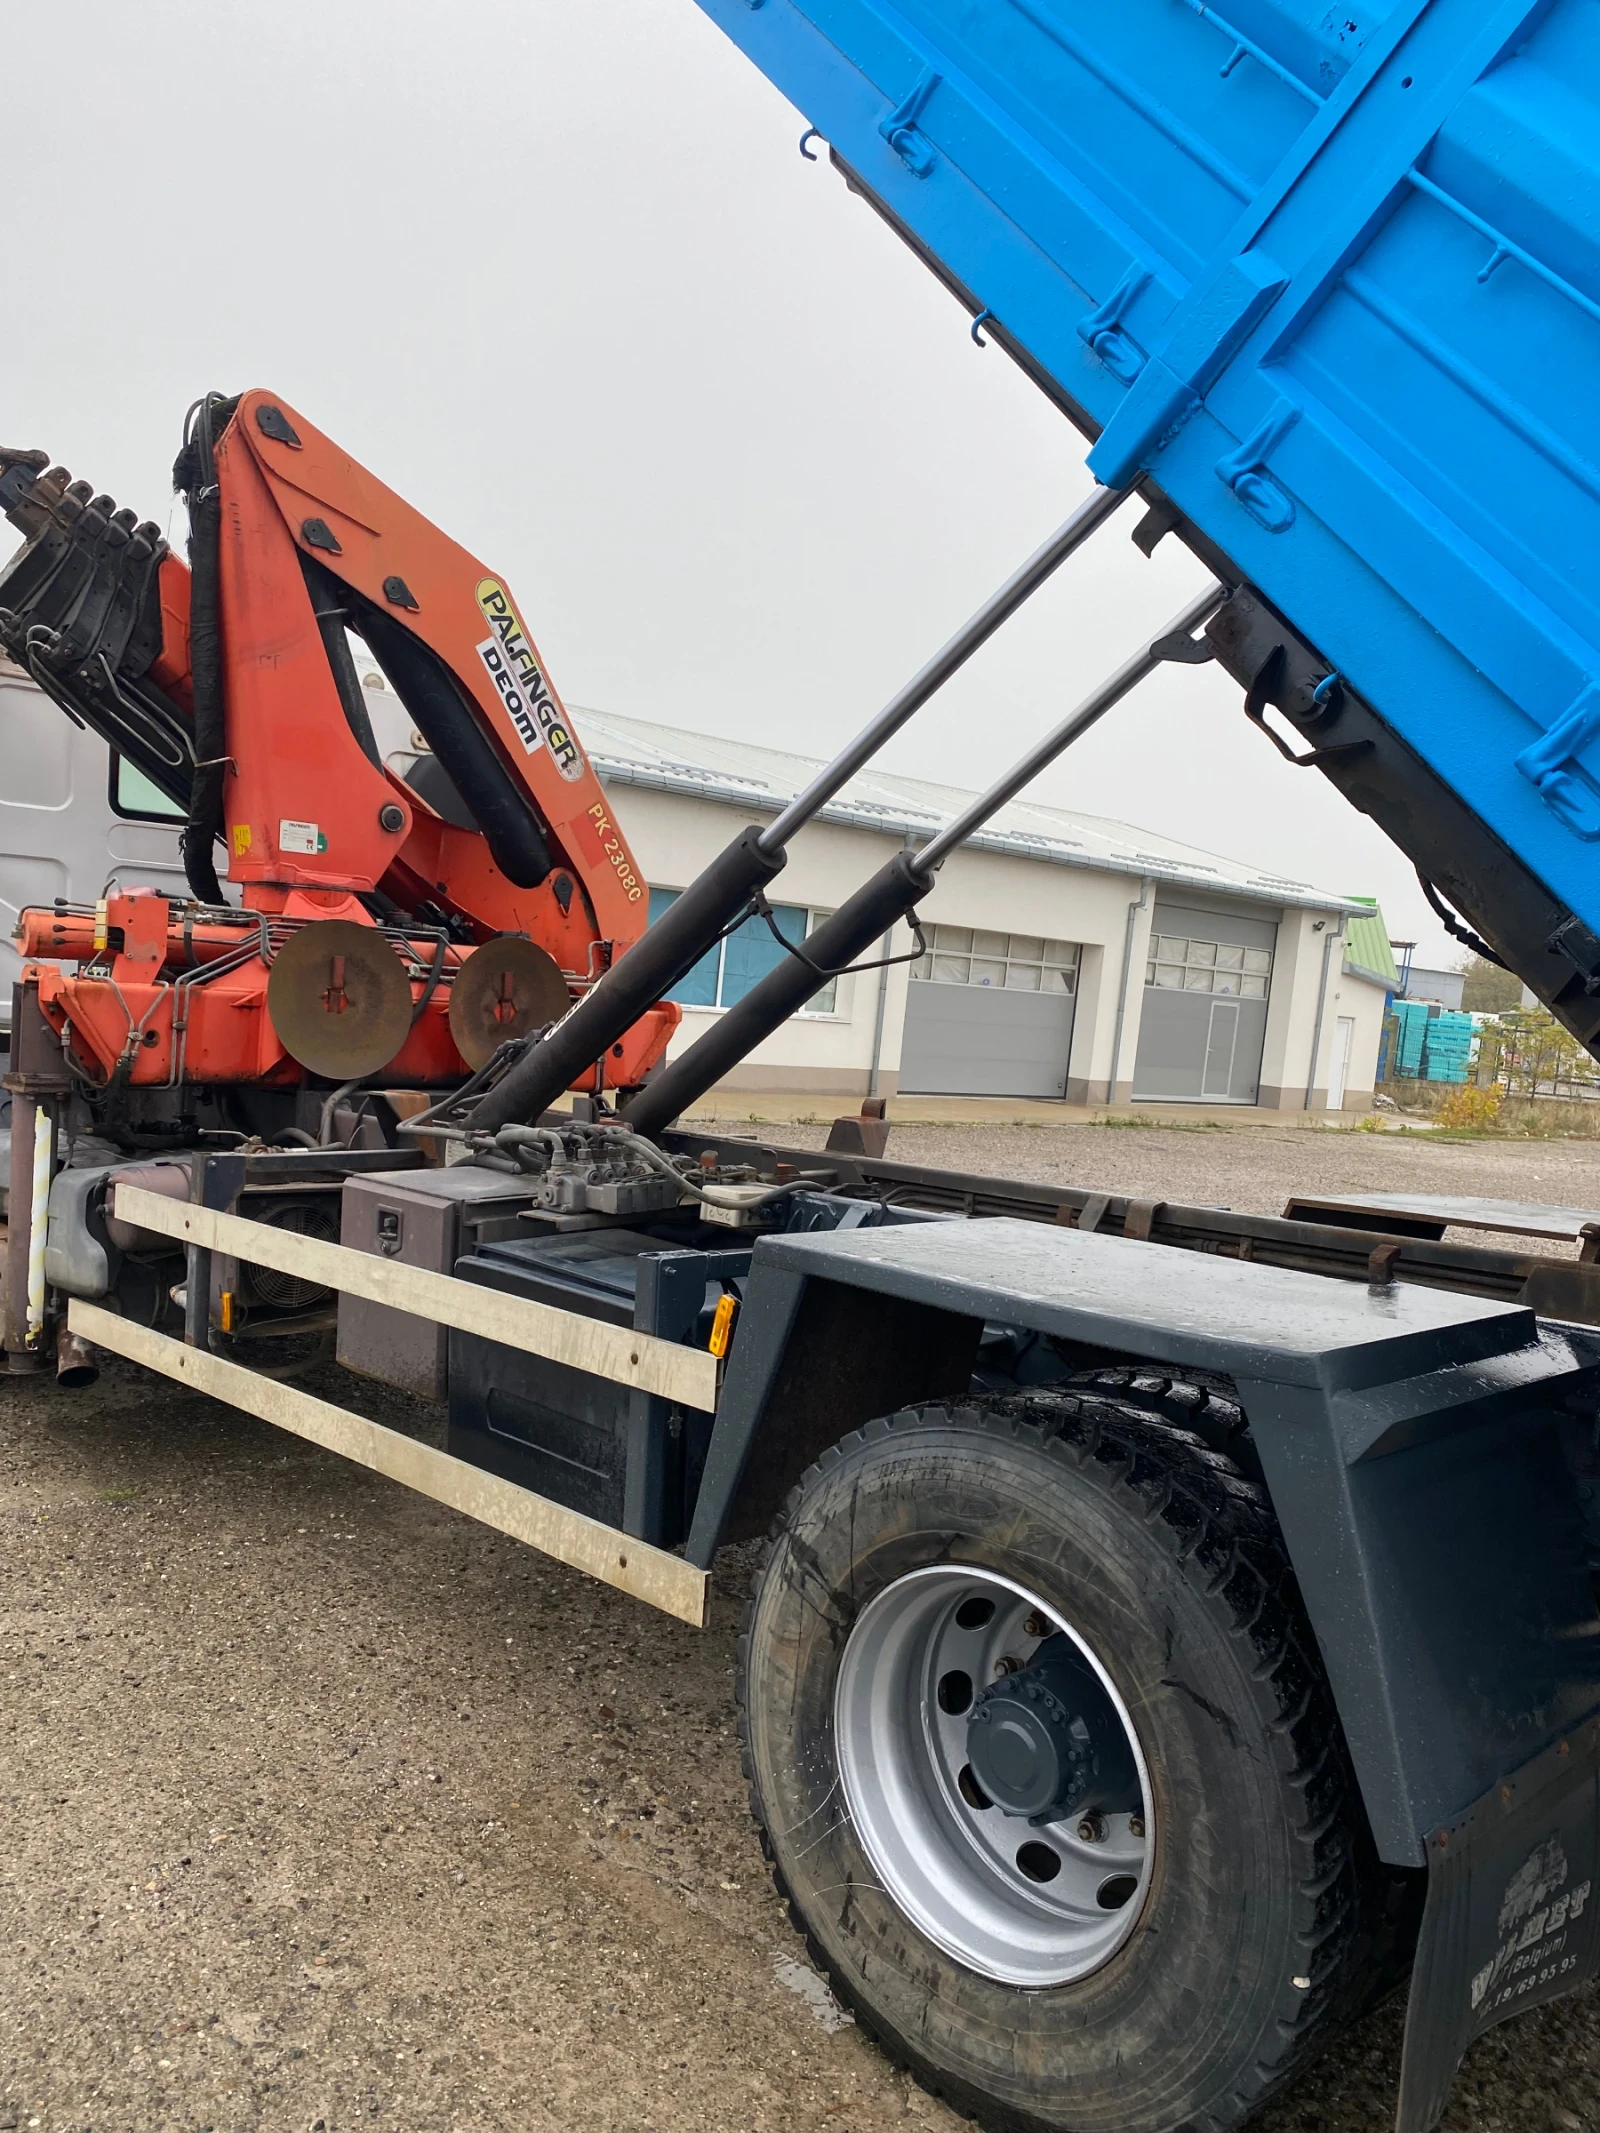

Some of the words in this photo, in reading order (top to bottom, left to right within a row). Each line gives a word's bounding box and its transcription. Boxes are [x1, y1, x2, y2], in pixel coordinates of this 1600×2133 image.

[482, 590, 577, 768] PALFINGER
[482, 646, 538, 746] DEOM
[587, 803, 611, 838] PK
[1538, 1963, 1558, 1985] 95
[1560, 1952, 1578, 1974] 95
